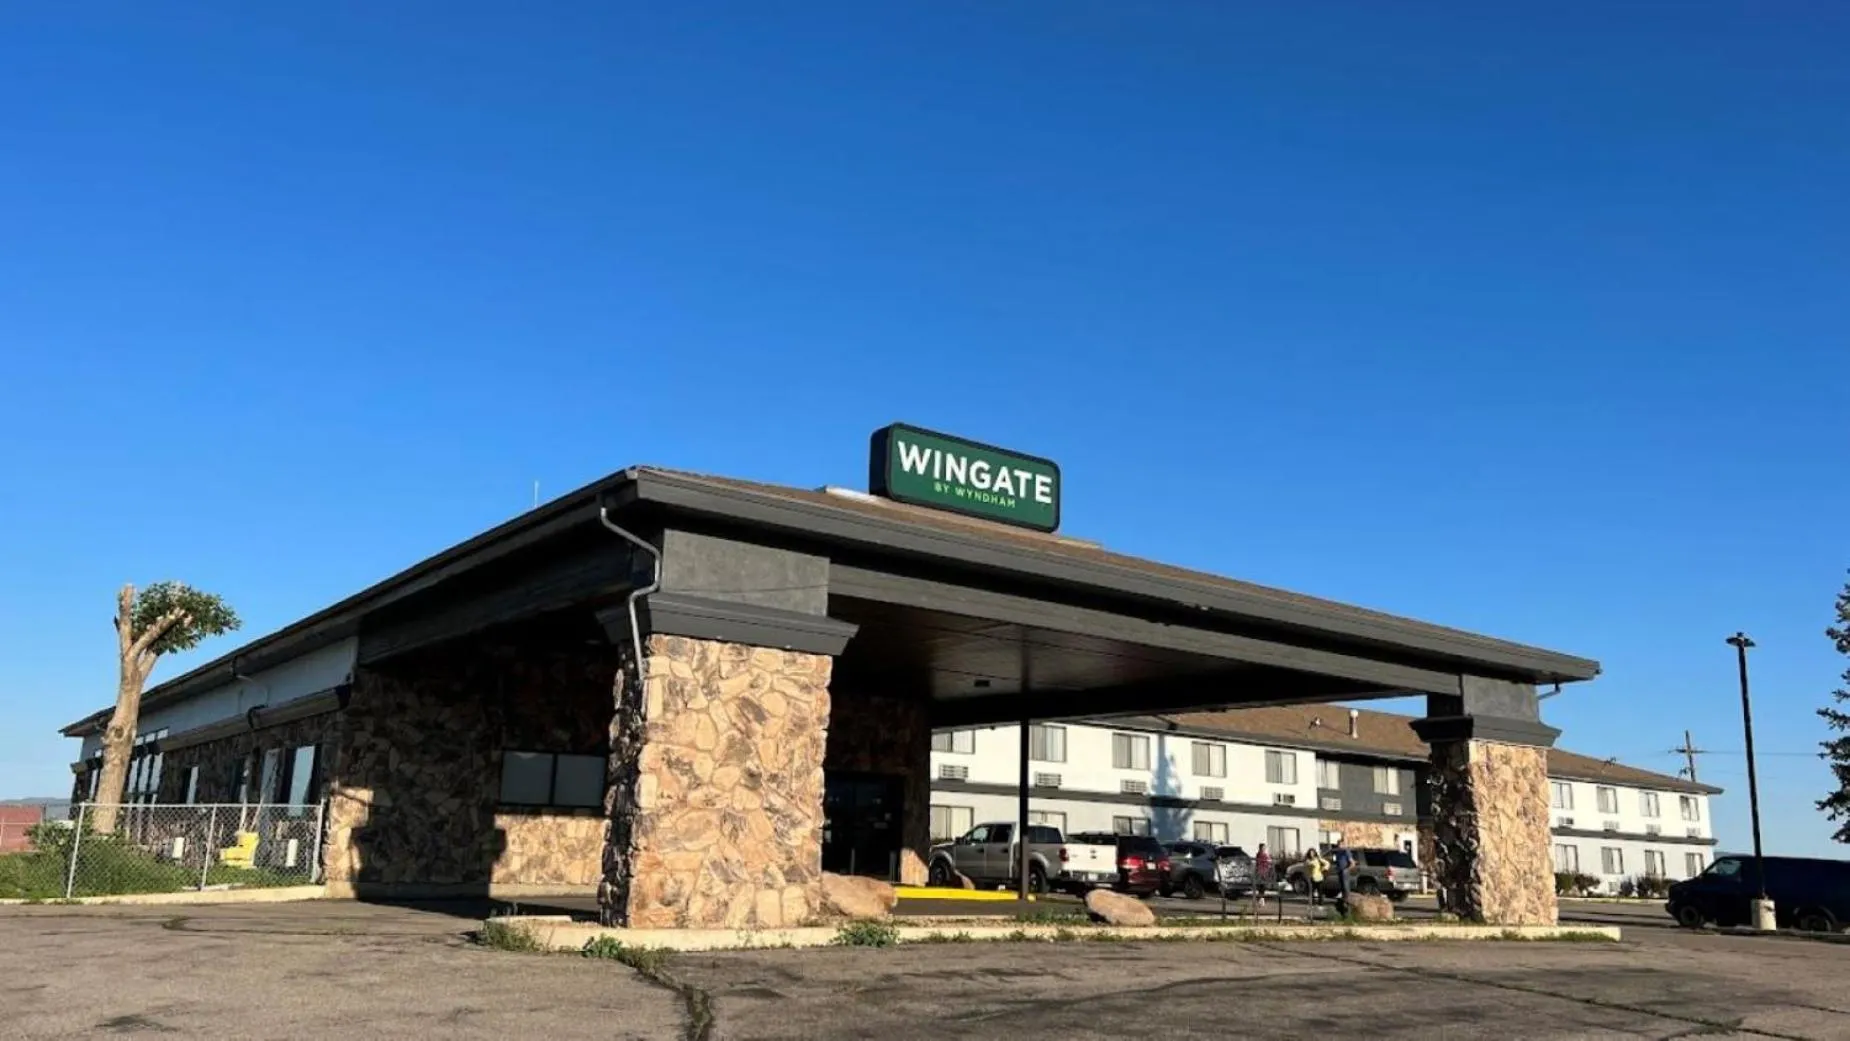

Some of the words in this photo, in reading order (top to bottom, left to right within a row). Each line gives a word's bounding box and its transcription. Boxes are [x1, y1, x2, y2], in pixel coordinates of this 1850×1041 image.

[898, 441, 1052, 503] WINGATE
[934, 482, 949, 493] BY
[956, 487, 1016, 508] WYNDHAM
